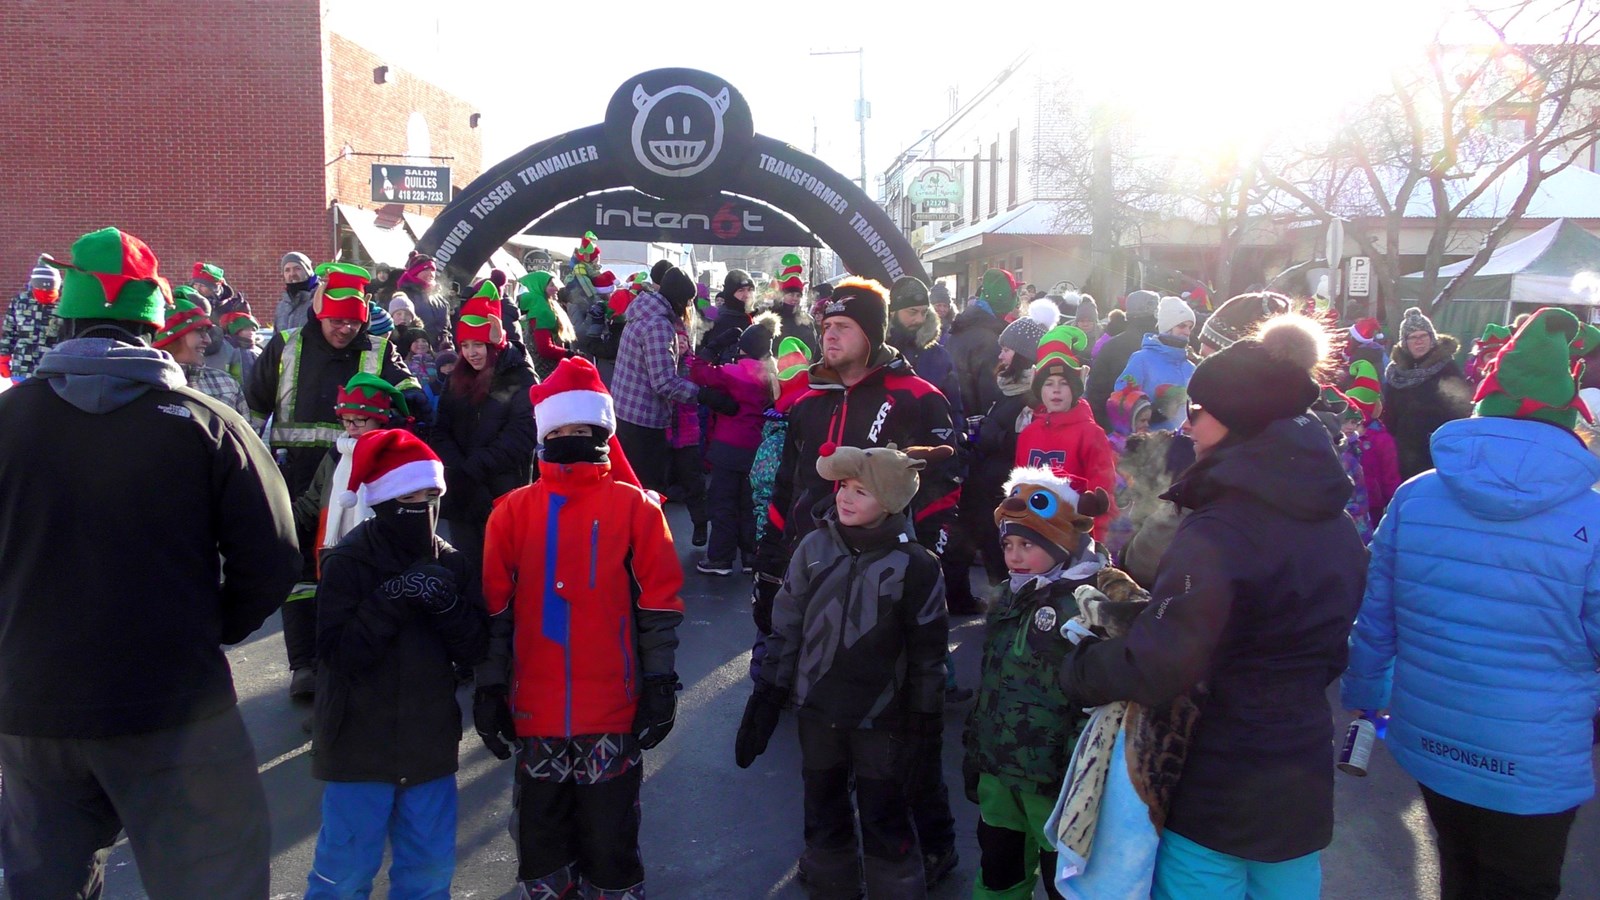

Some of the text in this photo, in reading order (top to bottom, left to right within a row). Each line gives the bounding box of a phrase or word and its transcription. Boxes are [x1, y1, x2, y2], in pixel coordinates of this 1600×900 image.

[404, 169, 438, 177] SALON
[404, 176, 438, 189] QUILLES
[758, 153, 849, 215] TRANSFORMER
[398, 190, 444, 202] 418 228-7233
[432, 145, 599, 277] ROUVER TISSER TRAVAILLER
[866, 401, 892, 444] FXR
[1420, 737, 1516, 777] RESPONSABLE
